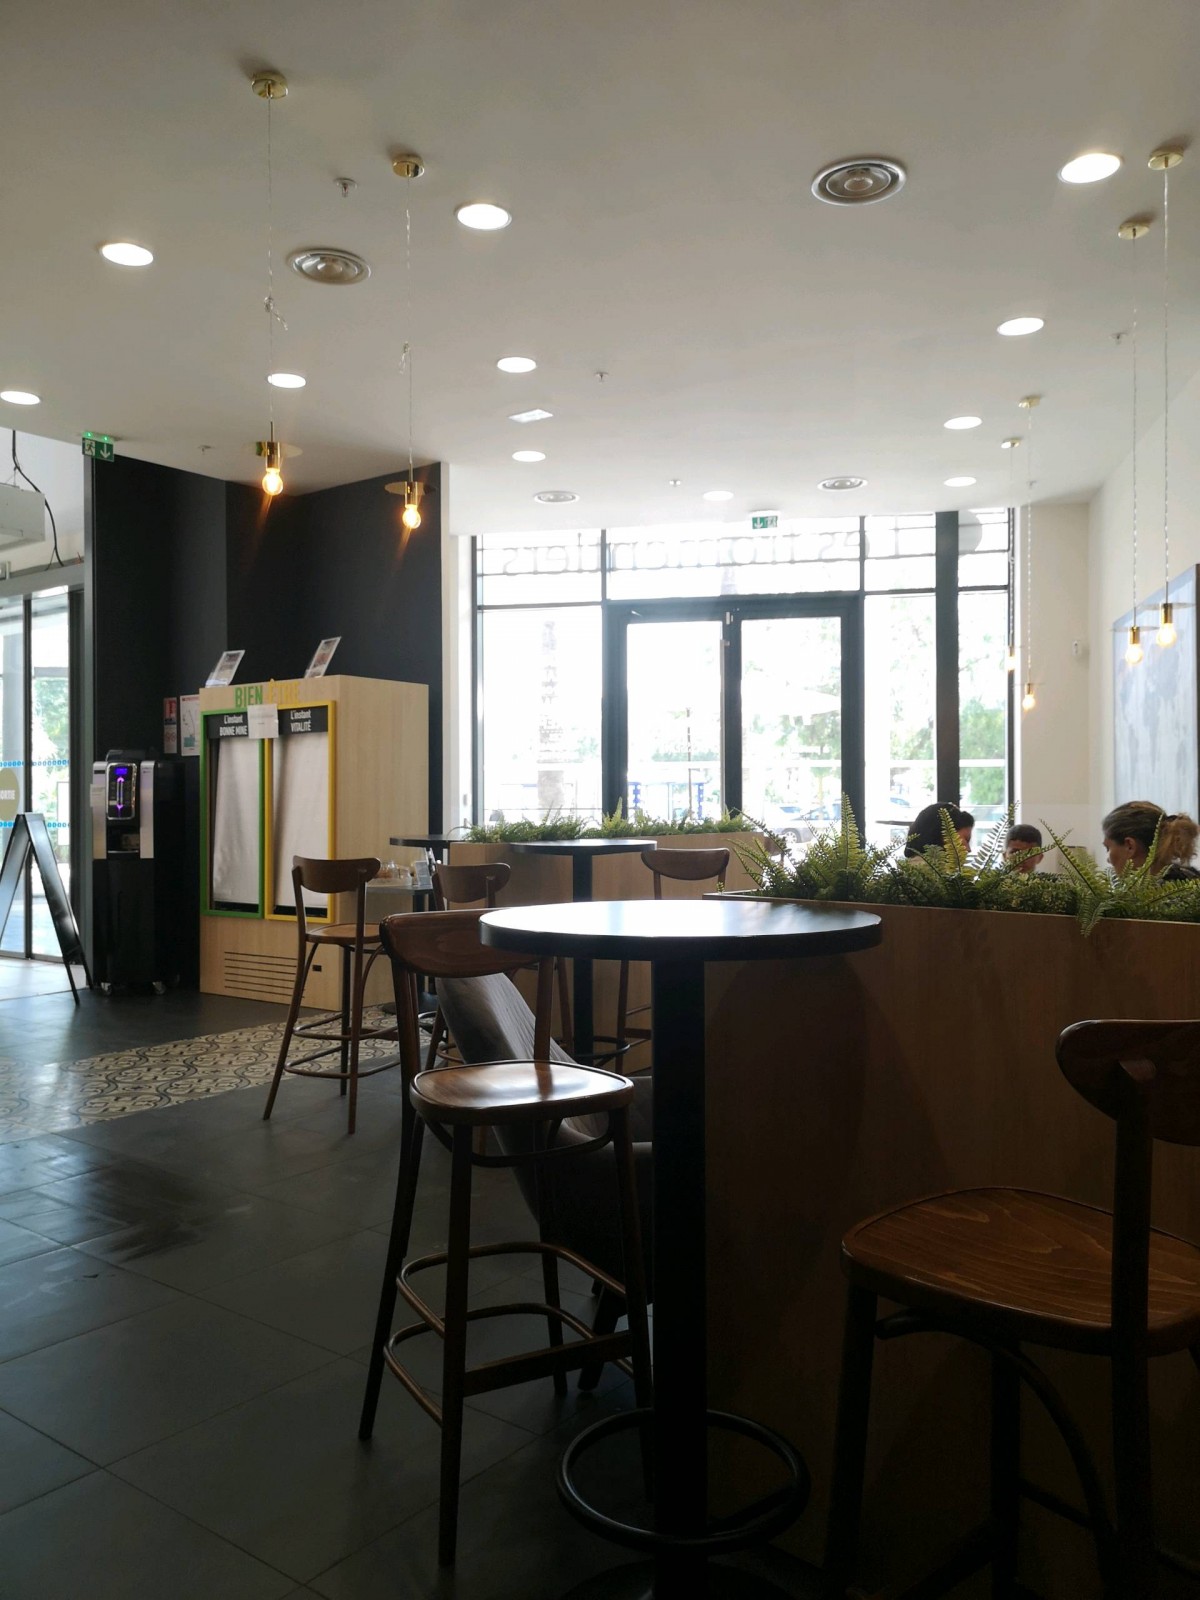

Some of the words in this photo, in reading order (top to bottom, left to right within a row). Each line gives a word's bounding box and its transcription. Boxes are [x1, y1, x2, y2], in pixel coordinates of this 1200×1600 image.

[235, 685, 263, 708] BIEN
[224, 715, 243, 725] L'instant
[290, 709, 311, 720] L'instant
[219, 726, 235, 737] BONNE
[235, 725, 247, 736] MINE
[290, 720, 311, 732] VITALITÉ
[0, 789, 15, 800] ORTIE
